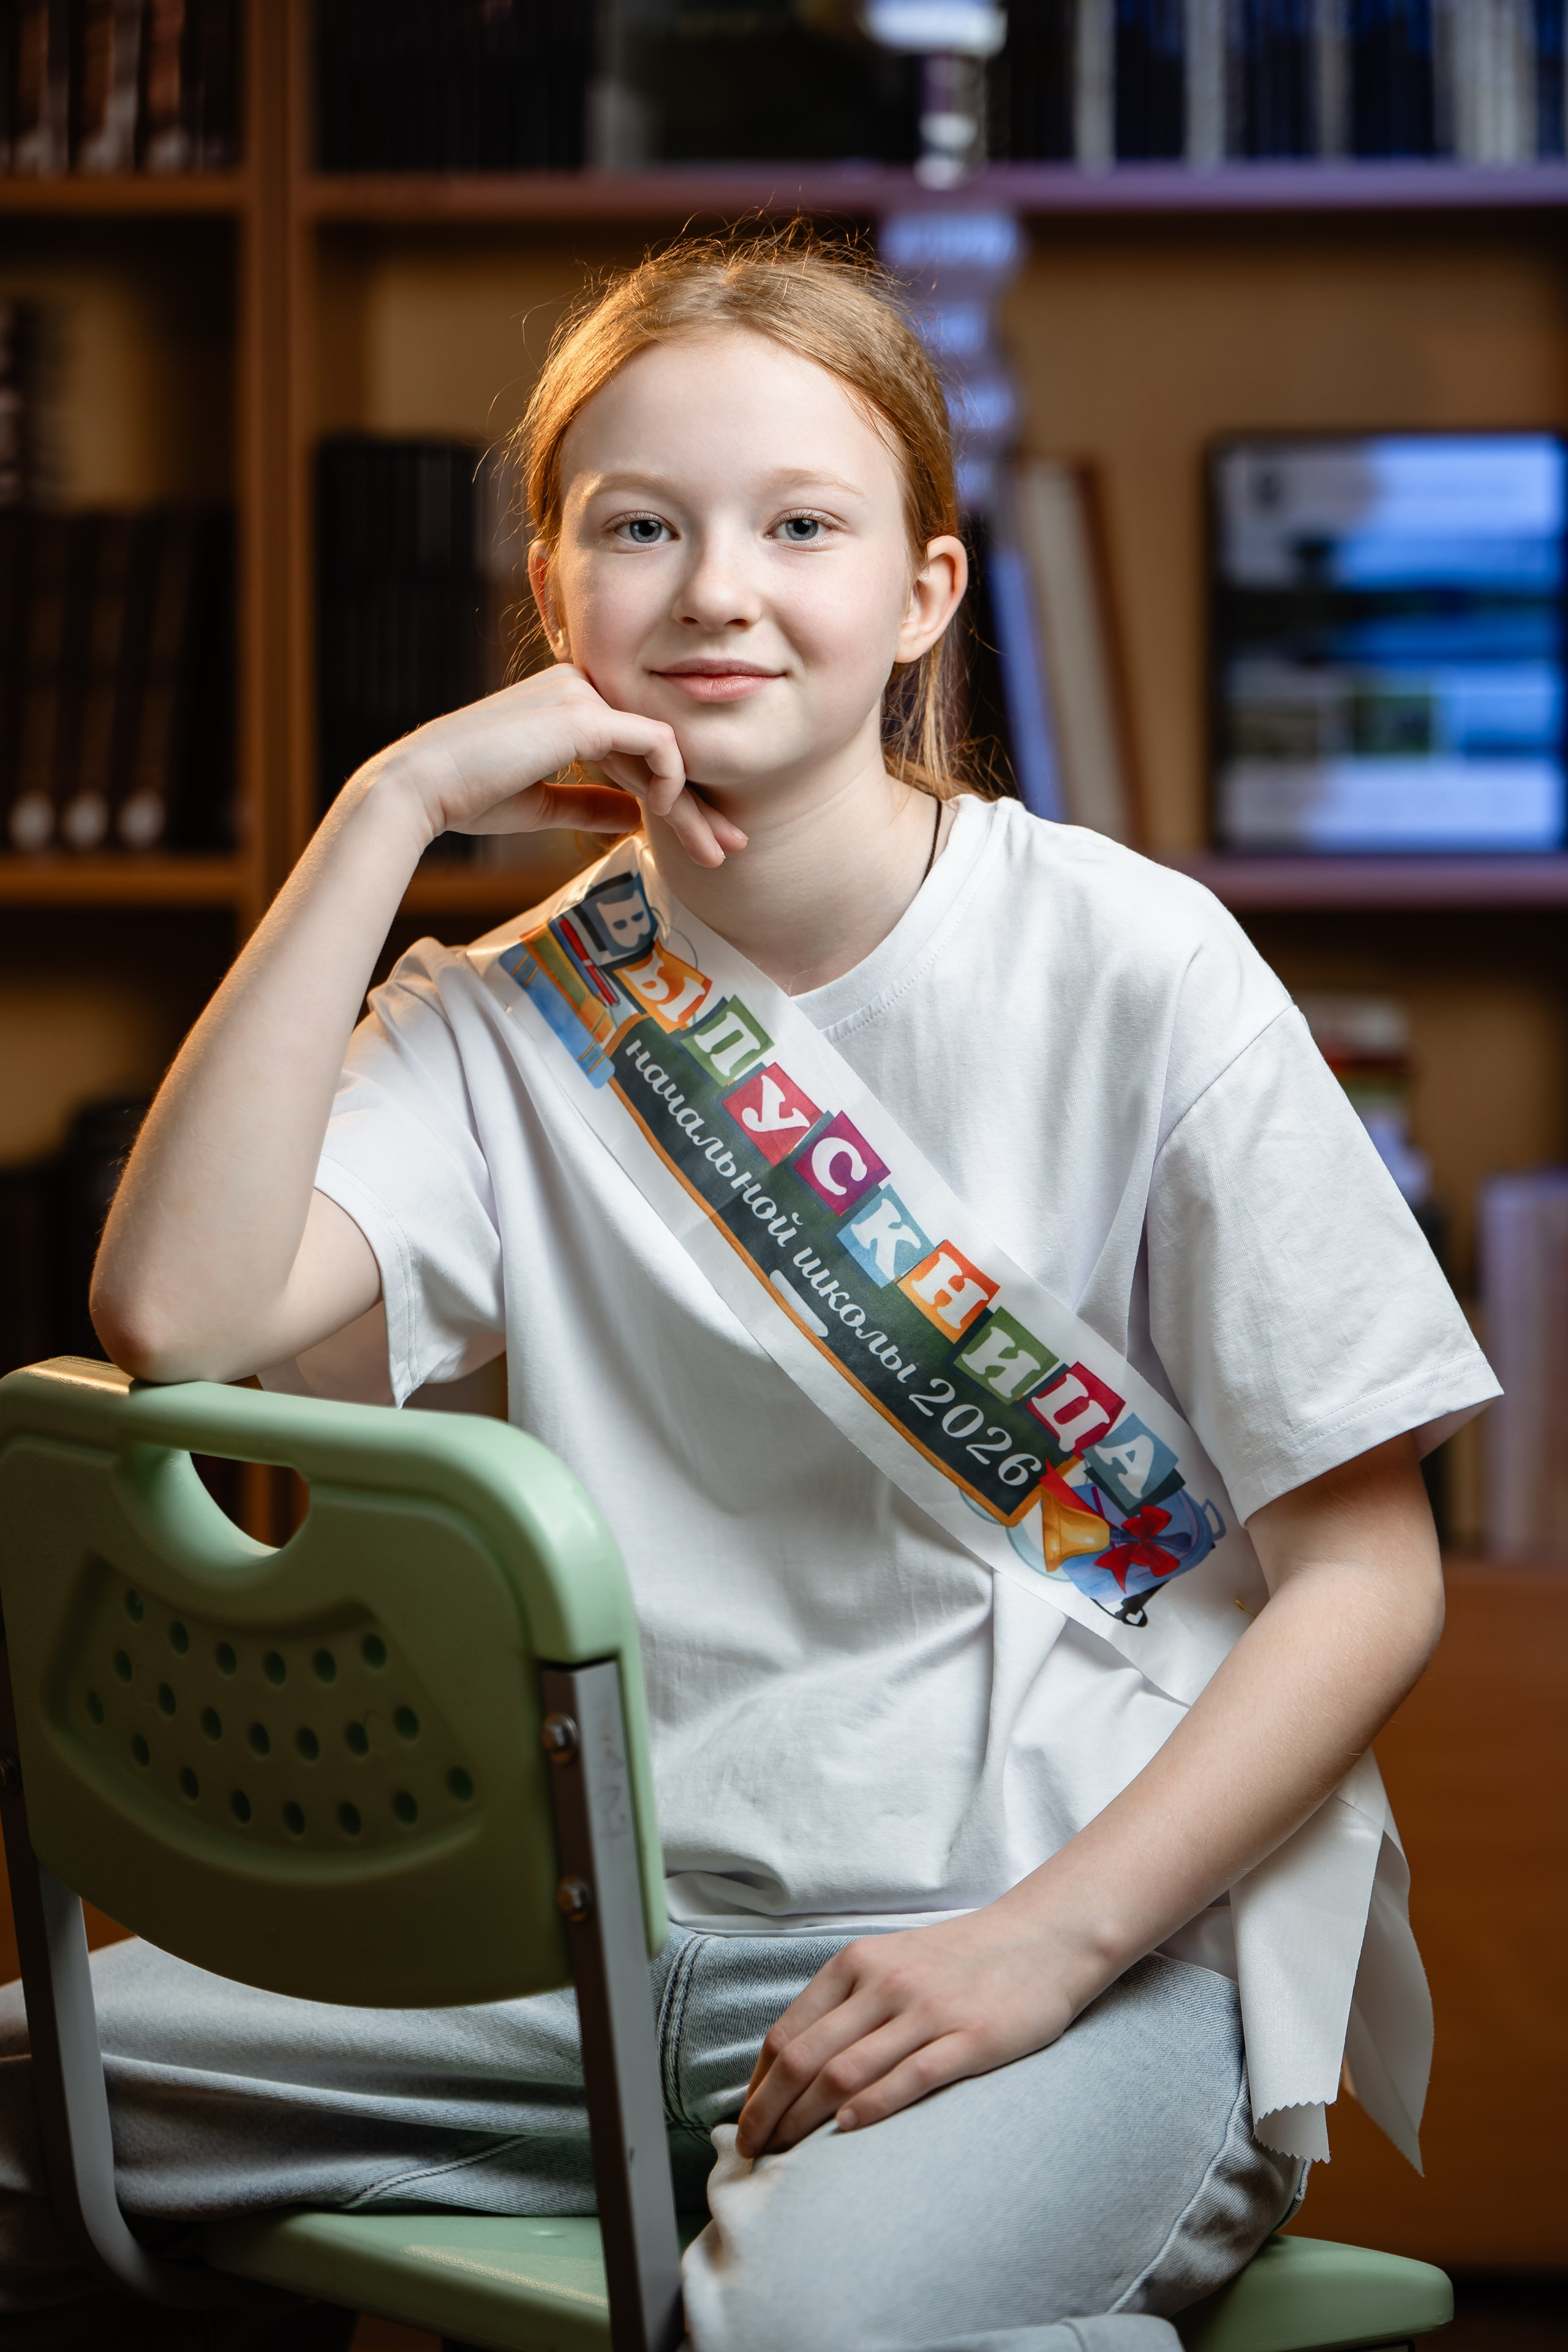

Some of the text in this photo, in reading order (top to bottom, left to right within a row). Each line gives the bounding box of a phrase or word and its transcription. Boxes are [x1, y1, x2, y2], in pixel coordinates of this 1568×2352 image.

[596, 888, 1156, 1498] ВЫПУСКНИЦА
[626, 1039, 1042, 1487] начальной школы 2026
